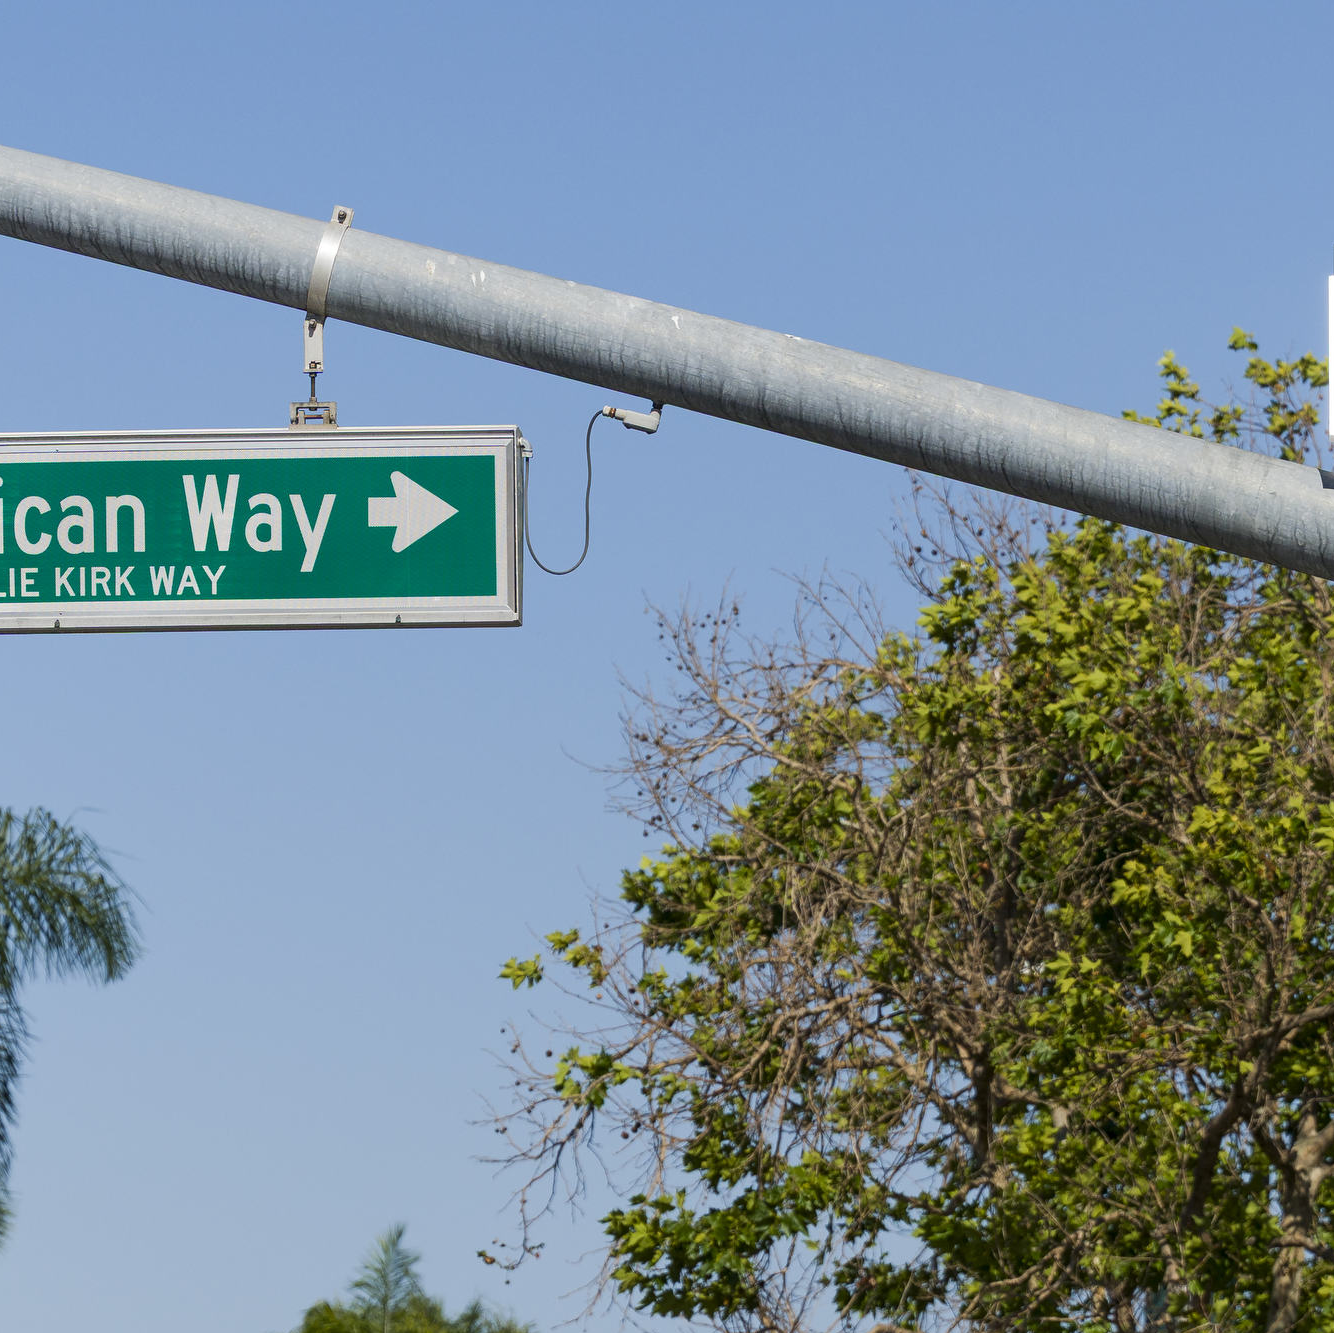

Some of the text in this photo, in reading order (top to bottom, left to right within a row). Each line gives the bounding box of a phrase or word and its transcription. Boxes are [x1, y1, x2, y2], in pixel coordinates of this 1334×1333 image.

[181, 473, 337, 573] Way
[53, 565, 138, 598] KIRK
[148, 564, 228, 597] WAY
